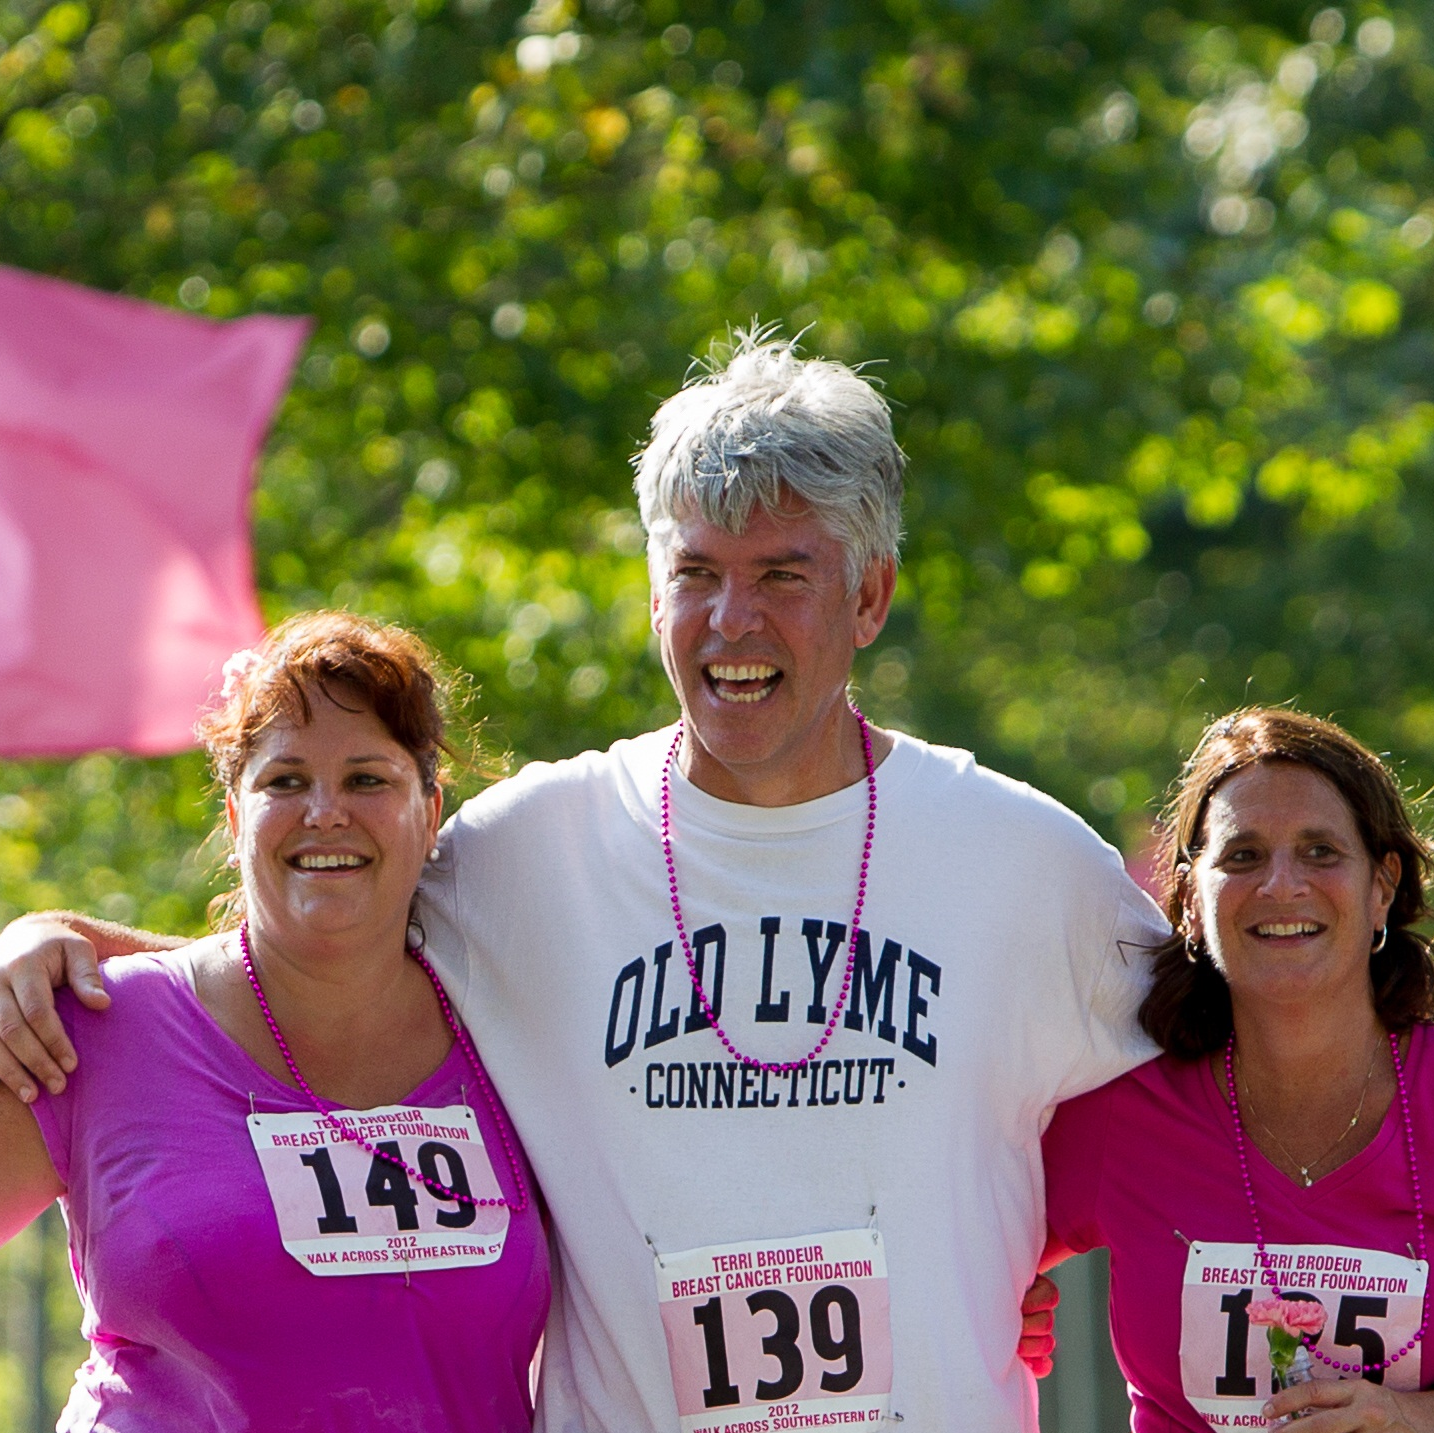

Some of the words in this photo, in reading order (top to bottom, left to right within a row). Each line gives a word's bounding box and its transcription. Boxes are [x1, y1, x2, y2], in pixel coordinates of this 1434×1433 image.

[604, 922, 727, 1069] OLD
[754, 915, 942, 1068] LYME
[313, 1116, 355, 1130] TERI
[272, 1131, 326, 1147] BREAST
[390, 1123, 470, 1142] FOUNDATION
[299, 1140, 477, 1234] 149
[342, 1250, 388, 1262] ACROSS
[392, 1244, 486, 1260] SOUTHEASTERN
[386, 1236, 418, 1249] 2012
[712, 1253, 753, 1273] TERRI
[757, 1245, 824, 1267] BRODEUR
[1296, 1255, 1362, 1273] BRODEUR
[671, 1276, 722, 1298] BREAST
[725, 1269, 782, 1290] CANCER
[786, 1260, 873, 1284] FOUNDATION
[1202, 1266, 1257, 1285] BREAST
[1320, 1273, 1408, 1293] FOUNDATION
[693, 1284, 864, 1409] 139
[768, 1403, 799, 1418] 2012
[773, 1410, 865, 1430] SOUTHEASTERN
[868, 1409, 880, 1421] CT
[1233, 1413, 1268, 1427] ACRO
